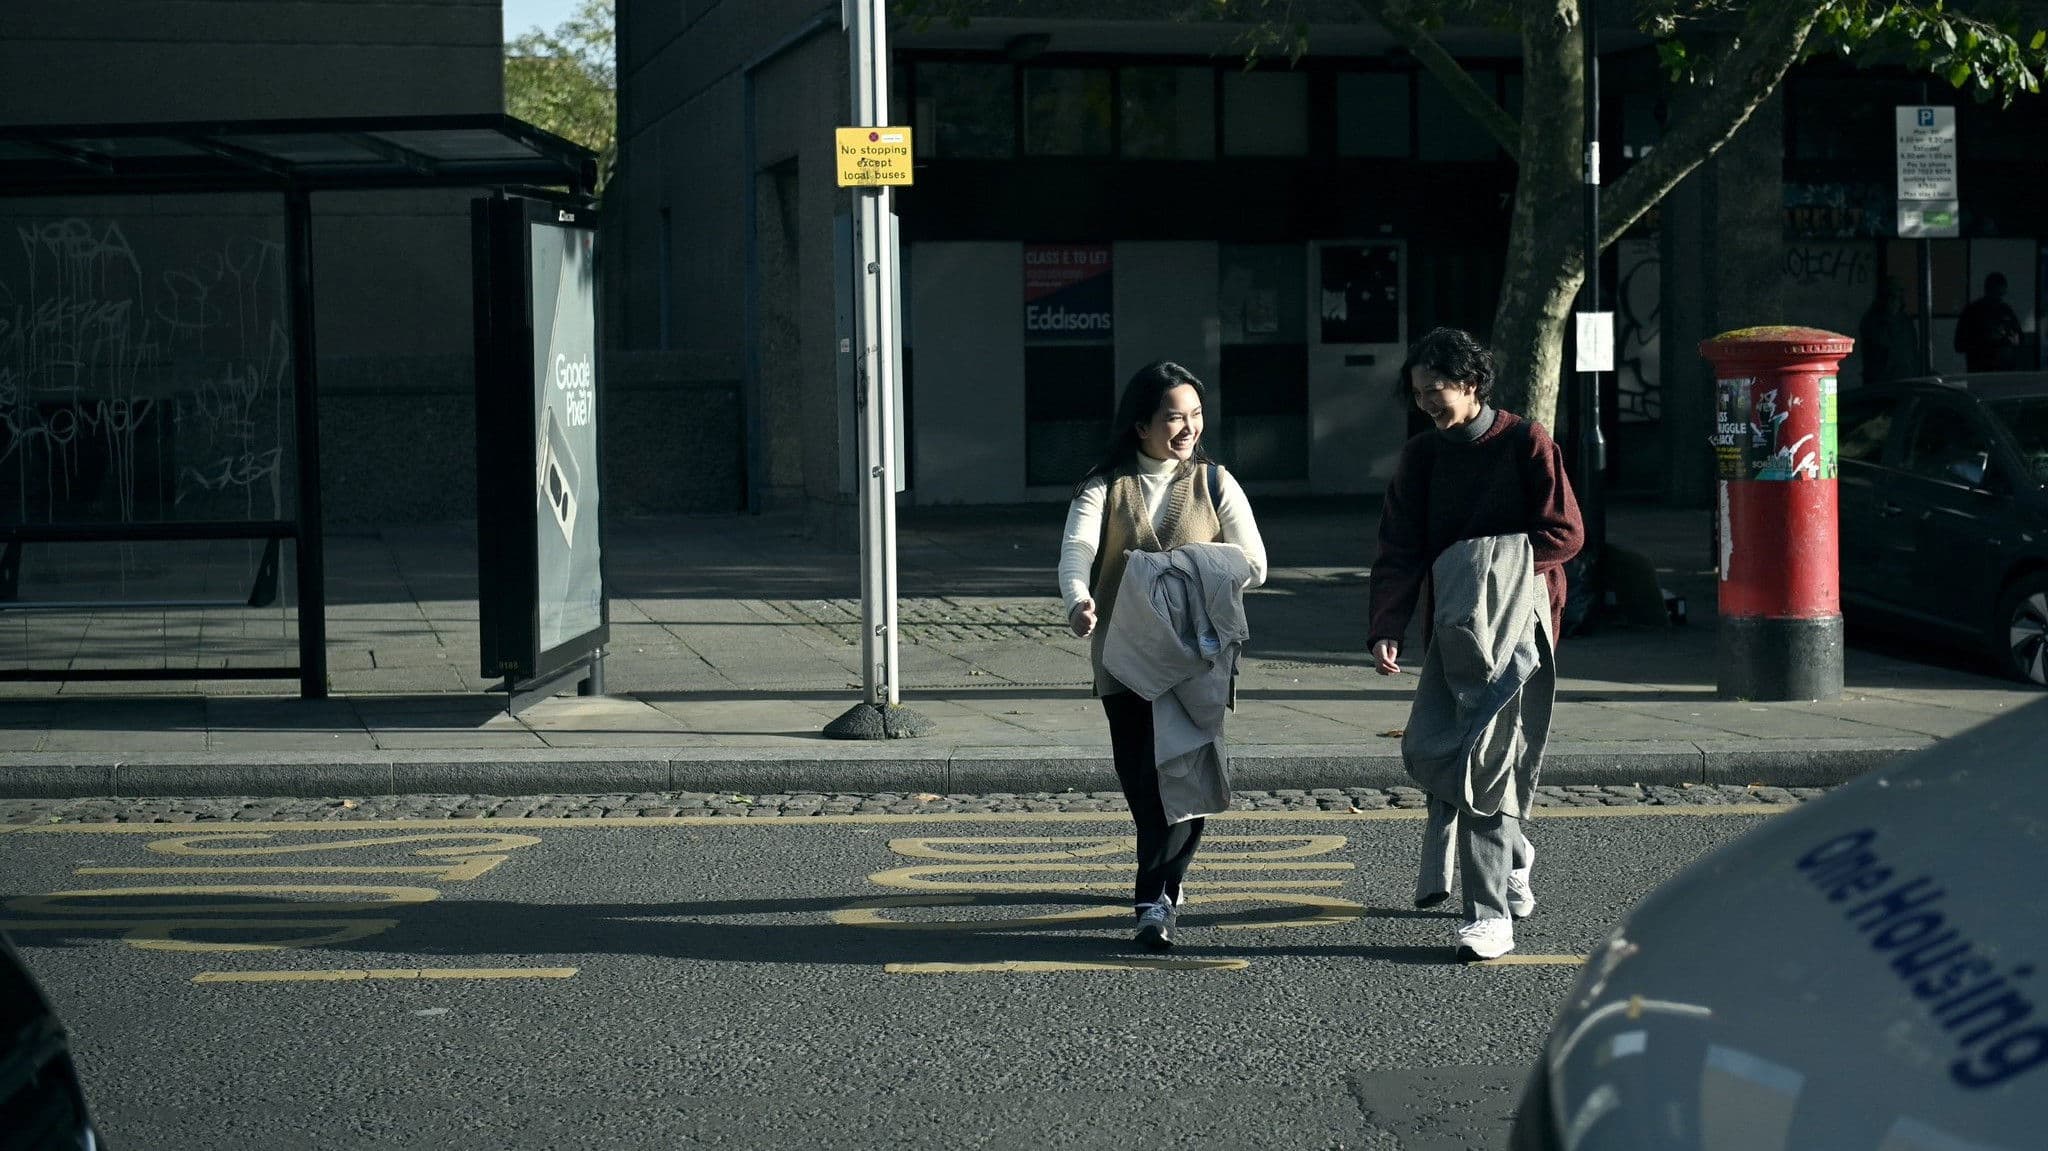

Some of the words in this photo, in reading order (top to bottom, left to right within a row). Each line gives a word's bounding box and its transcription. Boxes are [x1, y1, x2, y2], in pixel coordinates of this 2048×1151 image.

[1920, 110, 1932, 126] P
[841, 145, 856, 154] No
[861, 146, 907, 155] stopping
[857, 159, 892, 168] except
[844, 171, 869, 180] local
[874, 171, 906, 180] buses
[1026, 250, 1059, 265] CLASS
[1027, 304, 1112, 330] Eddisons
[555, 353, 590, 393] Google
[566, 389, 587, 427] Pixel
[1796, 828, 1893, 903] One
[1844, 876, 2048, 1089] Housing
